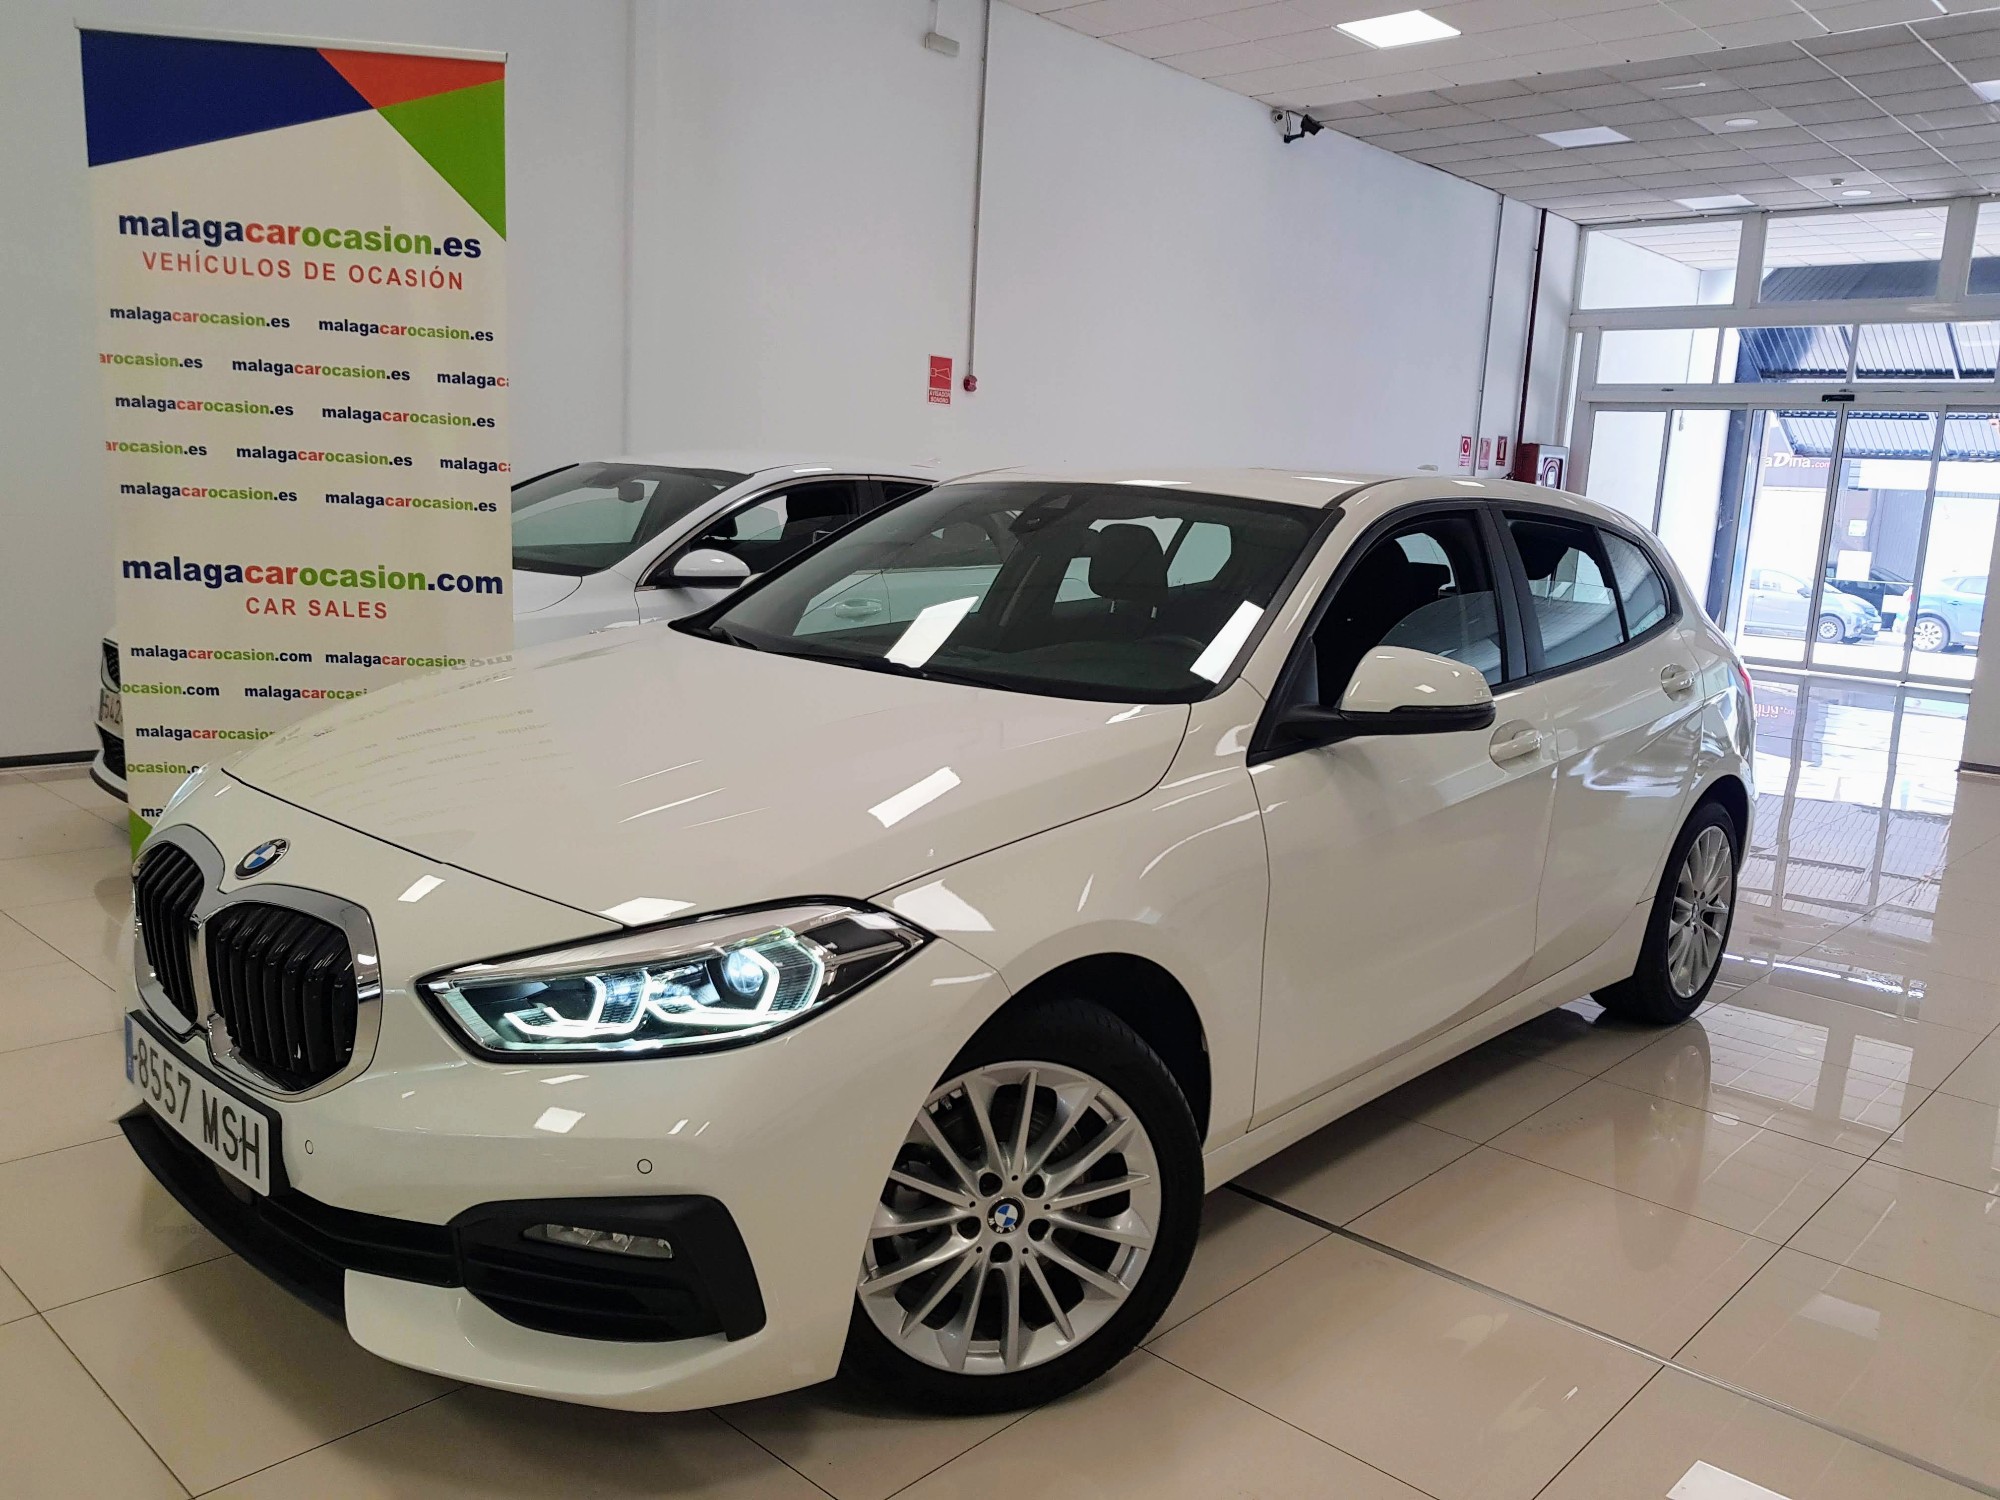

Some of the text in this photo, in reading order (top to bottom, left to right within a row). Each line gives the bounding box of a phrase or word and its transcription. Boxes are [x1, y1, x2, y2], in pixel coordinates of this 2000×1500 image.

[118, 211, 482, 259] malagacarocasion.es
[142, 250, 463, 290] VEHÍCULOS DE OCASIÓN
[110, 306, 494, 341] malagacarocasion.es malagacarocasion.es
[232, 358, 411, 380] malagacarocasion.es
[437, 371, 509, 389] malagac
[115, 395, 496, 428] malagacarocasion.es malagacarocasion.es
[236, 445, 413, 466] malagacarocasion.es
[440, 457, 511, 474] malagac
[120, 482, 497, 512] malagacarocasion.es malagacarocasion.es
[122, 556, 503, 594] malagacarocasion.com
[246, 597, 387, 619] CAR SALES
[131, 645, 313, 663] malagacarocasion.com
[121, 682, 220, 697] ocasion.com
[136, 725, 275, 741] malagacarocasio
[138, 1038, 260, 1179] 8557 MSH
